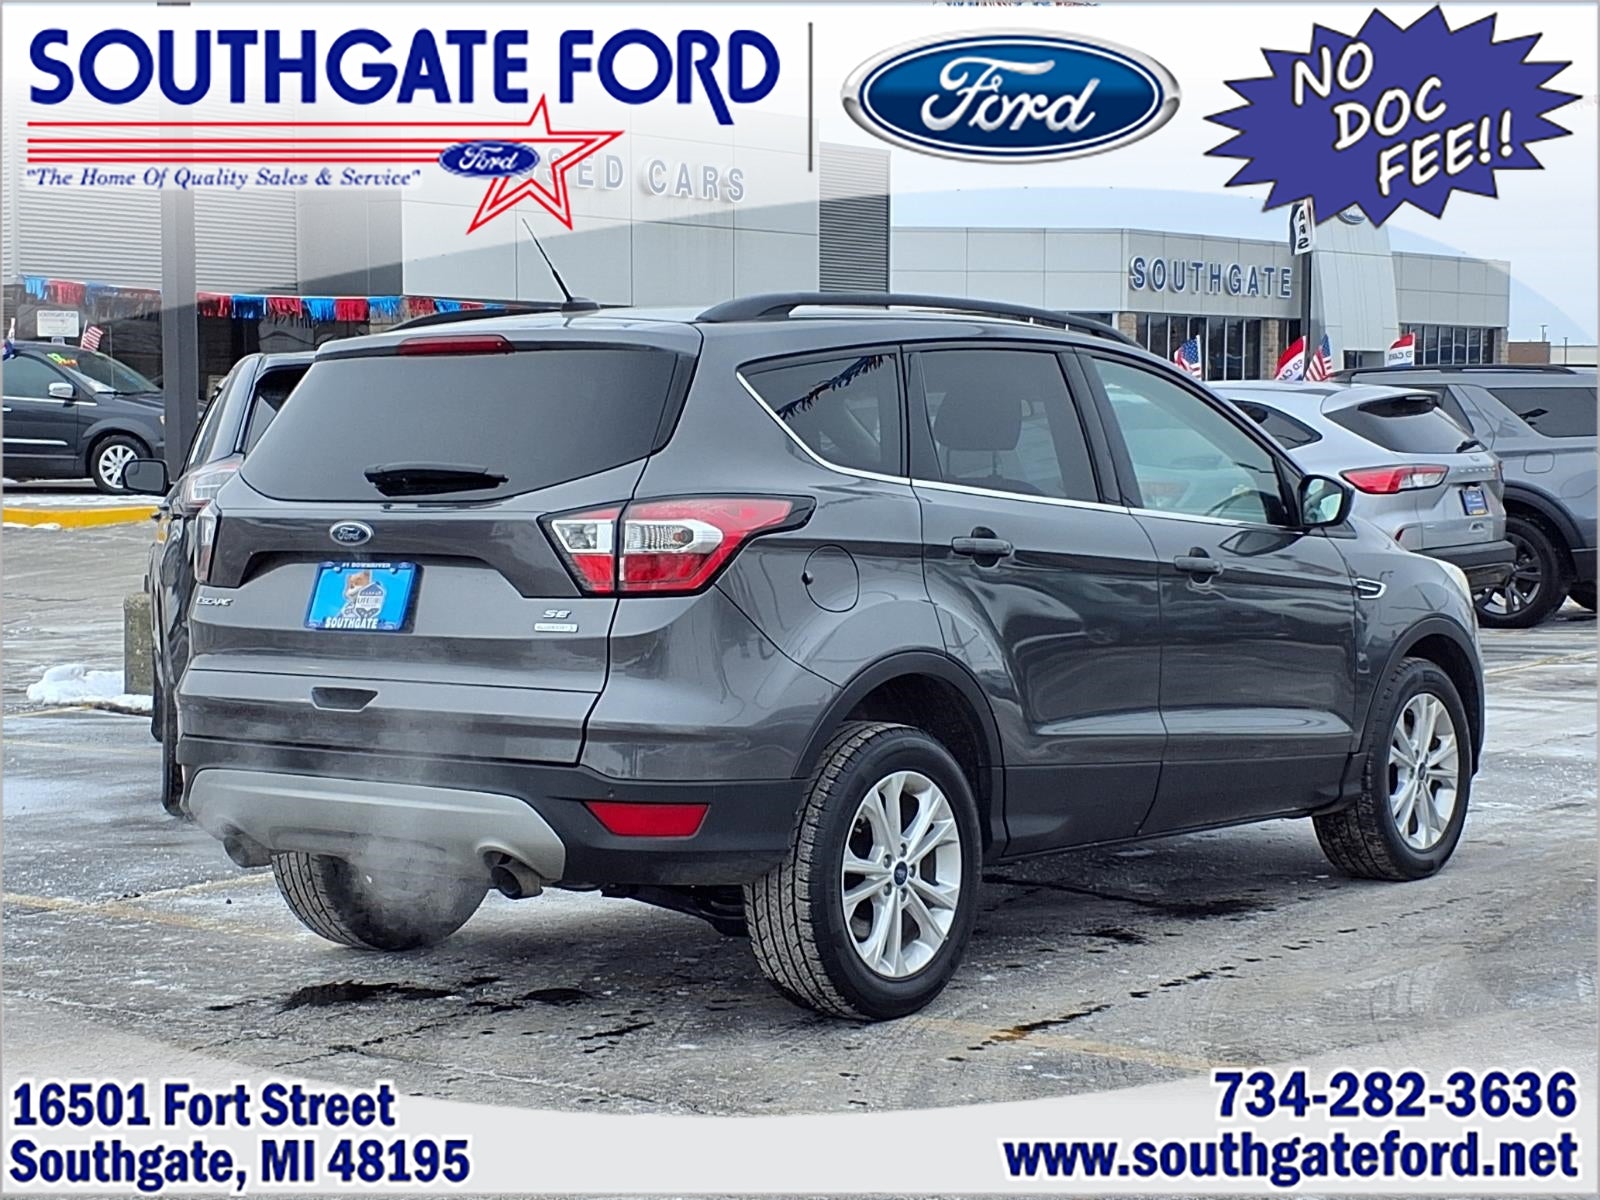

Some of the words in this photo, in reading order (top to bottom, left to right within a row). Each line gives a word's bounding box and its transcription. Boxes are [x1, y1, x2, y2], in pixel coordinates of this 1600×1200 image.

[518, 148, 623, 188] SED
[648, 159, 745, 201] CARS
[1131, 257, 1292, 297] SOUTHGATE
[325, 617, 379, 629] SOUTHGATE
[543, 609, 571, 619] SE
